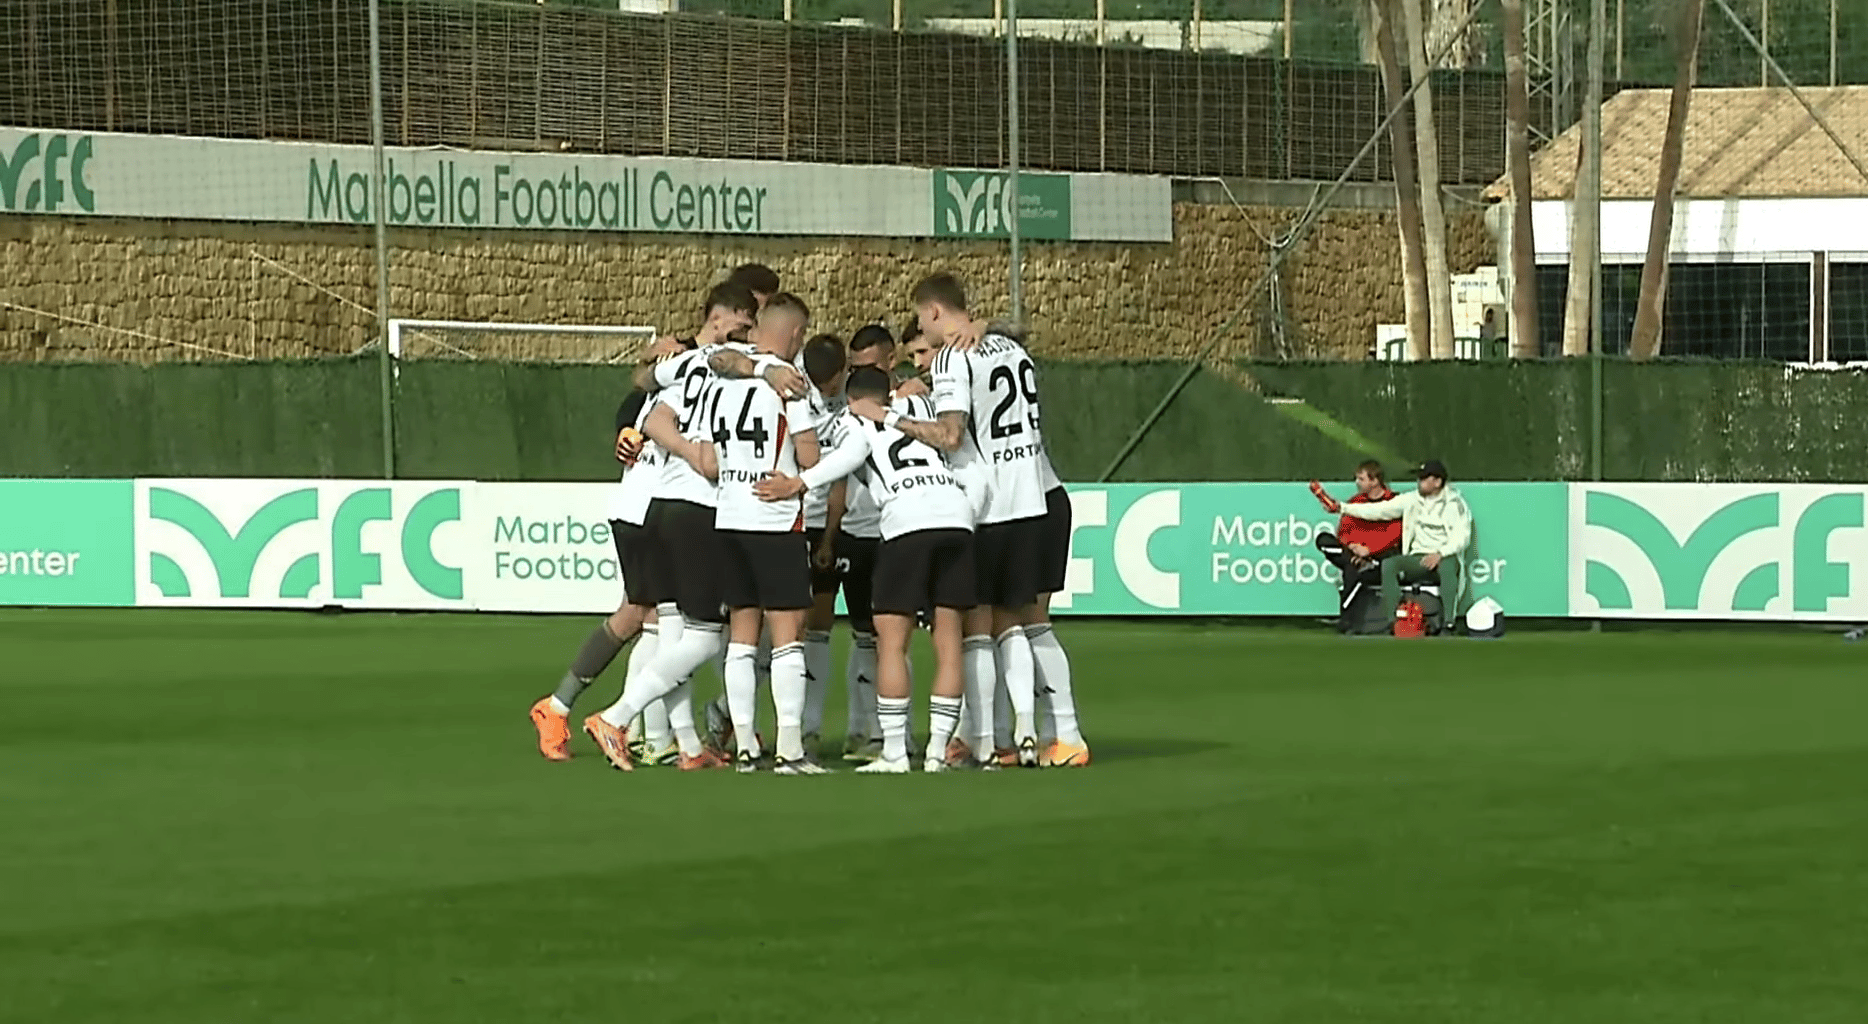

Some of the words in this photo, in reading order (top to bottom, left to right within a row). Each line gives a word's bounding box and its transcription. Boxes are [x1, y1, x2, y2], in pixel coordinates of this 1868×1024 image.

[308, 157, 481, 224] Mabella
[494, 164, 637, 229] Football
[649, 169, 767, 231] Center
[710, 387, 769, 459] 44
[989, 358, 1041, 440] 29
[874, 422, 933, 471] 2
